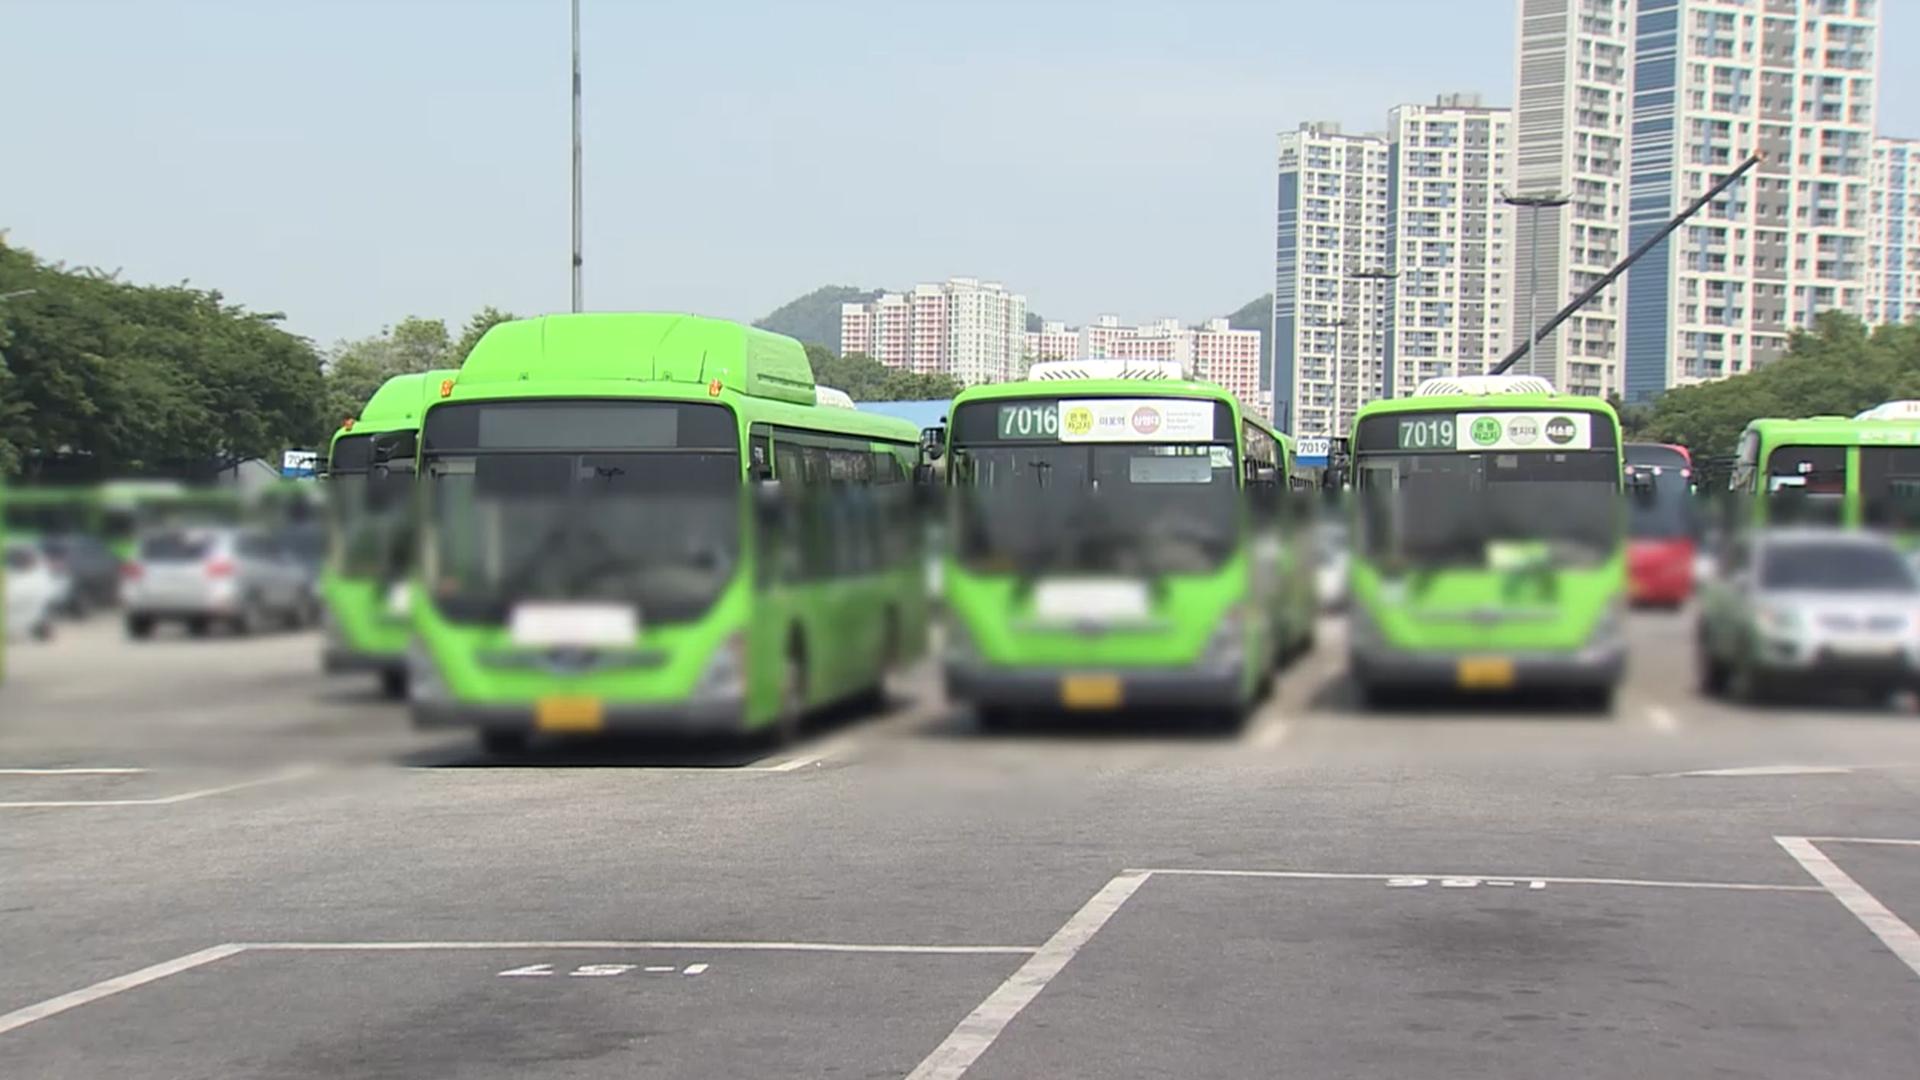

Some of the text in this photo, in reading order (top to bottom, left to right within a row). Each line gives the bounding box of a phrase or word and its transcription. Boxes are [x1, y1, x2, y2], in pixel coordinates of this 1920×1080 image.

[1002, 406, 1058, 435] 7016
[1401, 420, 1453, 447] 7019
[1300, 442, 1327, 453] 7019
